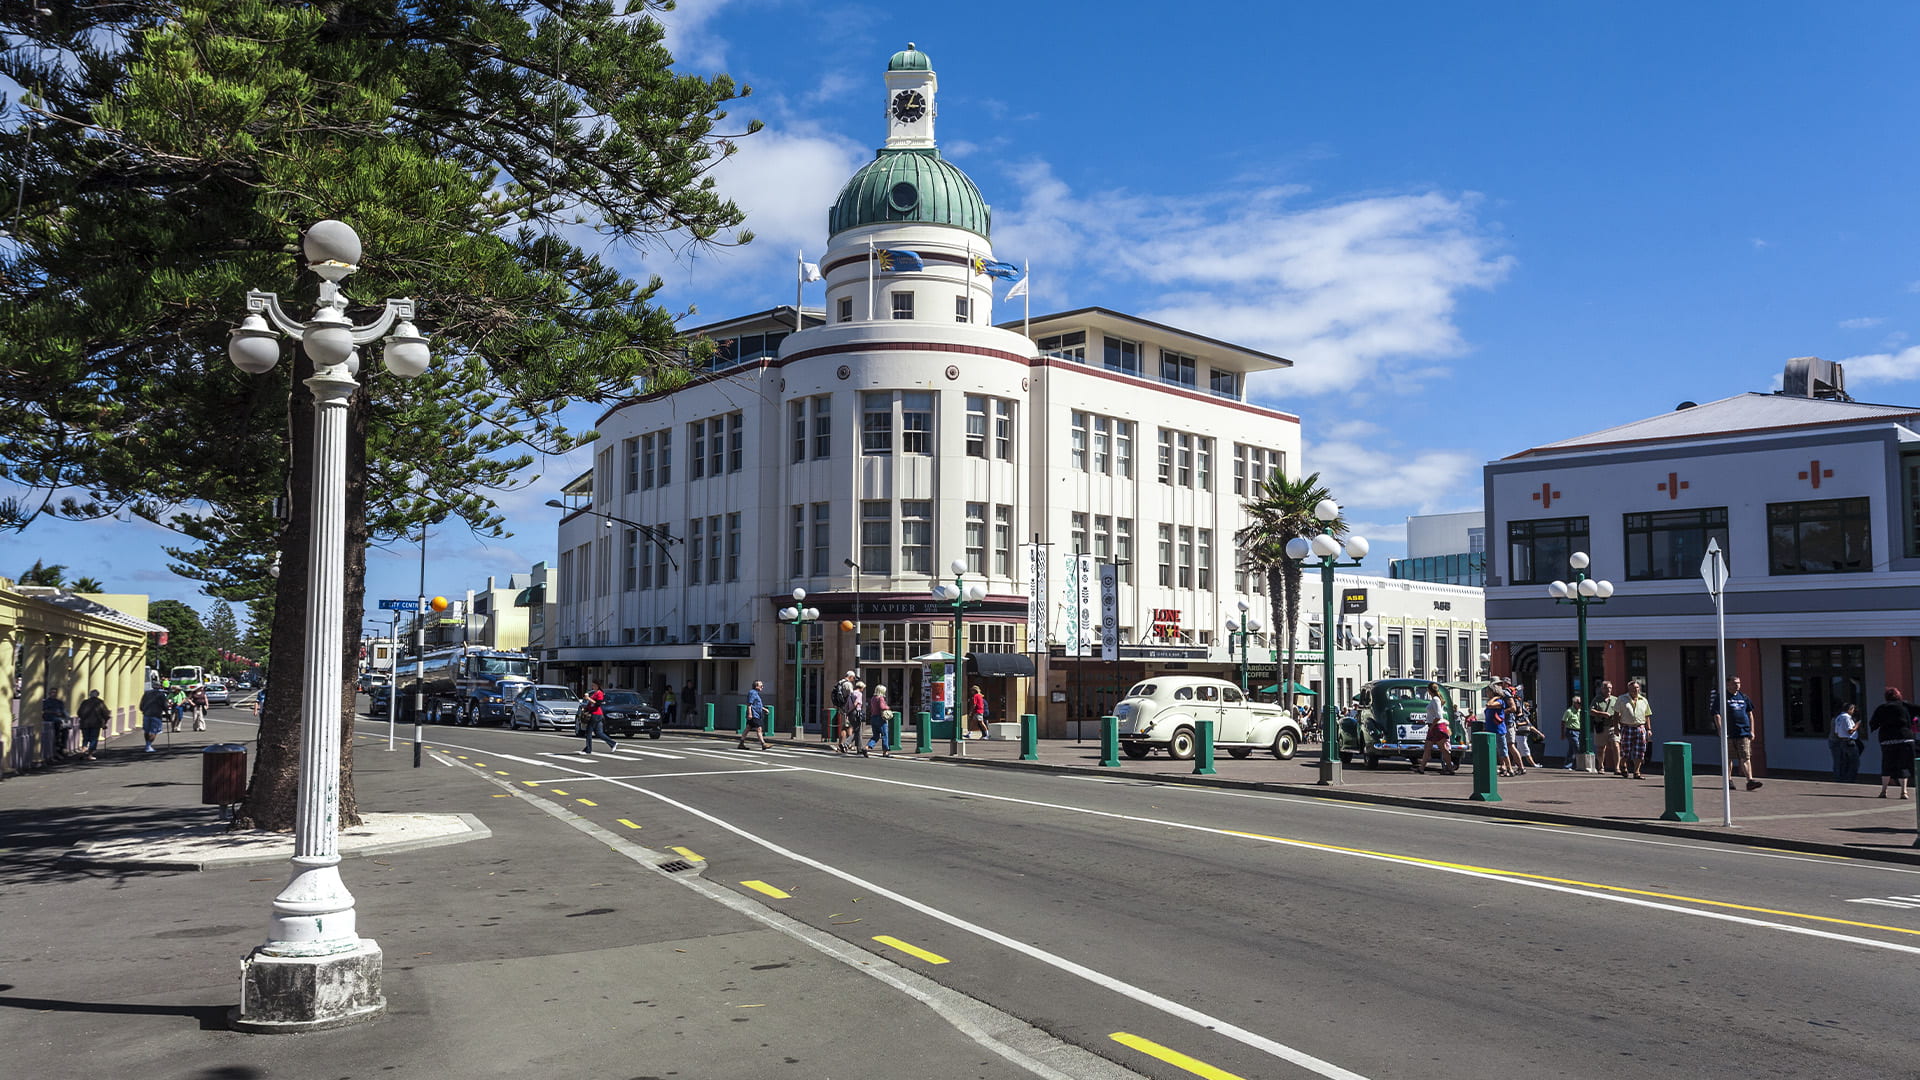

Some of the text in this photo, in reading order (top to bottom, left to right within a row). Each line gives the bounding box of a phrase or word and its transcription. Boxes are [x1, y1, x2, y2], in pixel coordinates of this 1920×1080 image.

[872, 603, 916, 612] NAPIER
[1433, 600, 1451, 611] ASB
[1153, 608, 1181, 622] LONE
